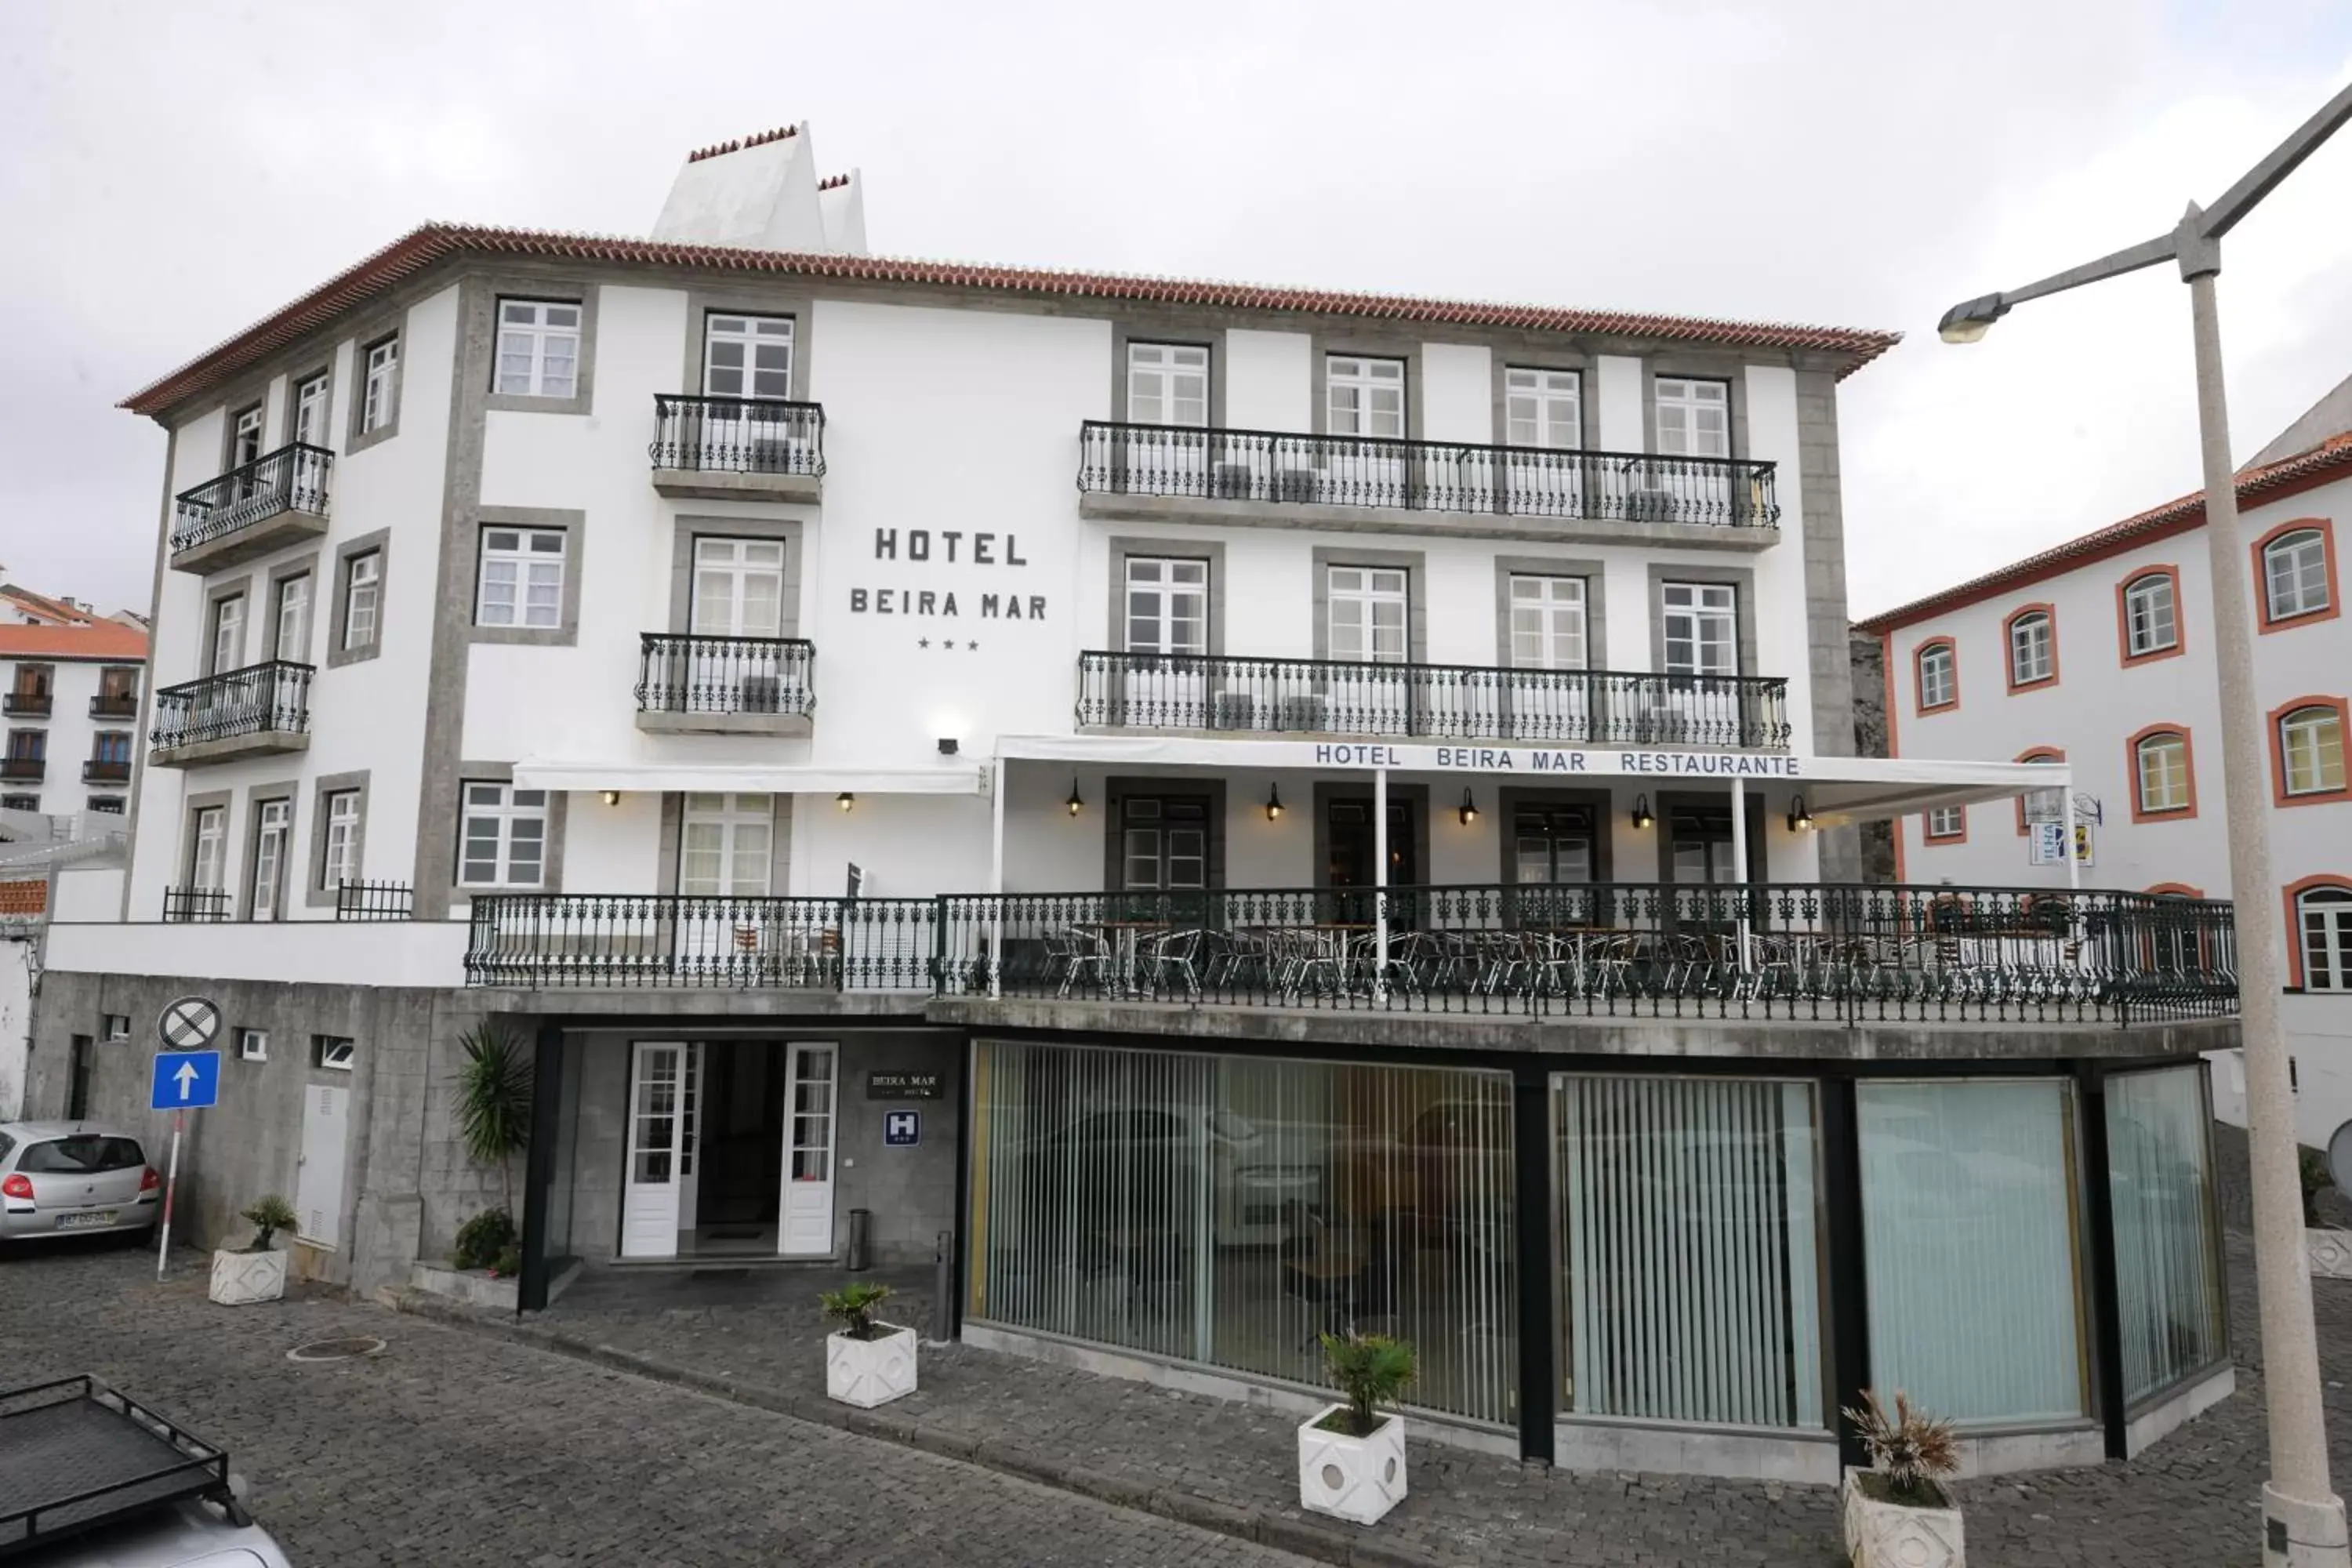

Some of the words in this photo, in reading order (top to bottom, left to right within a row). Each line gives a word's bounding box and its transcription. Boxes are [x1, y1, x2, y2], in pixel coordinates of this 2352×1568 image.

[875, 528, 1027, 566] HOTEL
[851, 588, 958, 616] BEIRA
[982, 593, 1046, 620] MAR
[1316, 745, 1401, 765] HOTEL
[1437, 748, 1513, 769] BEIRA
[1533, 752, 1585, 771] MAR
[1621, 753, 1800, 775] RESTAURANTE
[911, 1076, 935, 1086] MAR
[890, 1115, 915, 1135] H
